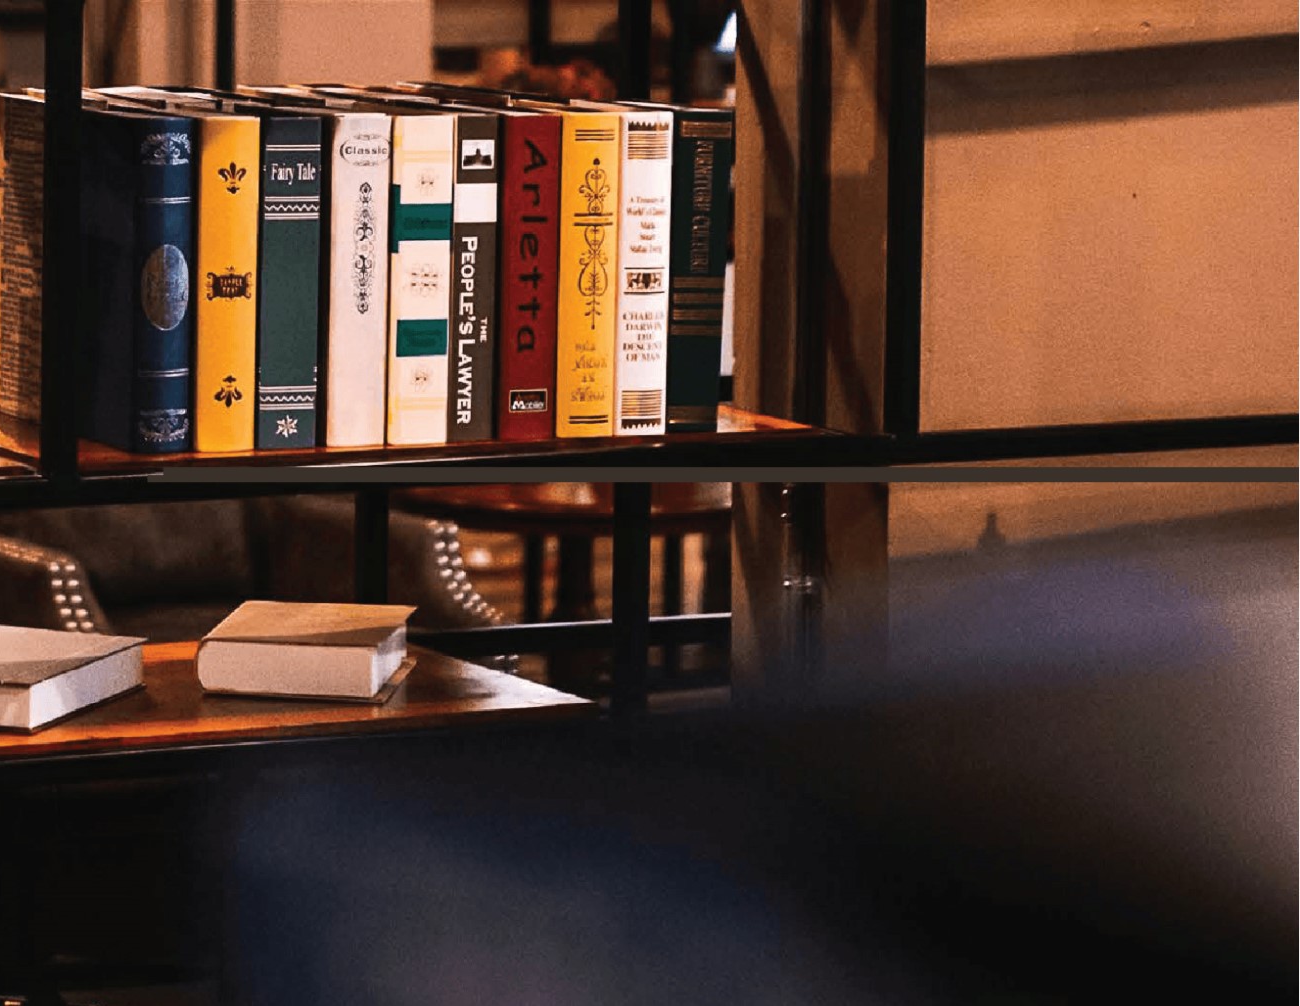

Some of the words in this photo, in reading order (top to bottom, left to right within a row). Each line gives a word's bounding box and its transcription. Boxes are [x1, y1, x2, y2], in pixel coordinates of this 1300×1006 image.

[271, 163, 294, 185] Fairy
[296, 163, 316, 182] Tale
[344, 145, 387, 155] Classic
[516, 139, 548, 353] Arletta
[457, 236, 478, 335] PEOPLE'S
[480, 318, 488, 343] THE
[456, 338, 476, 425] LAWYER
